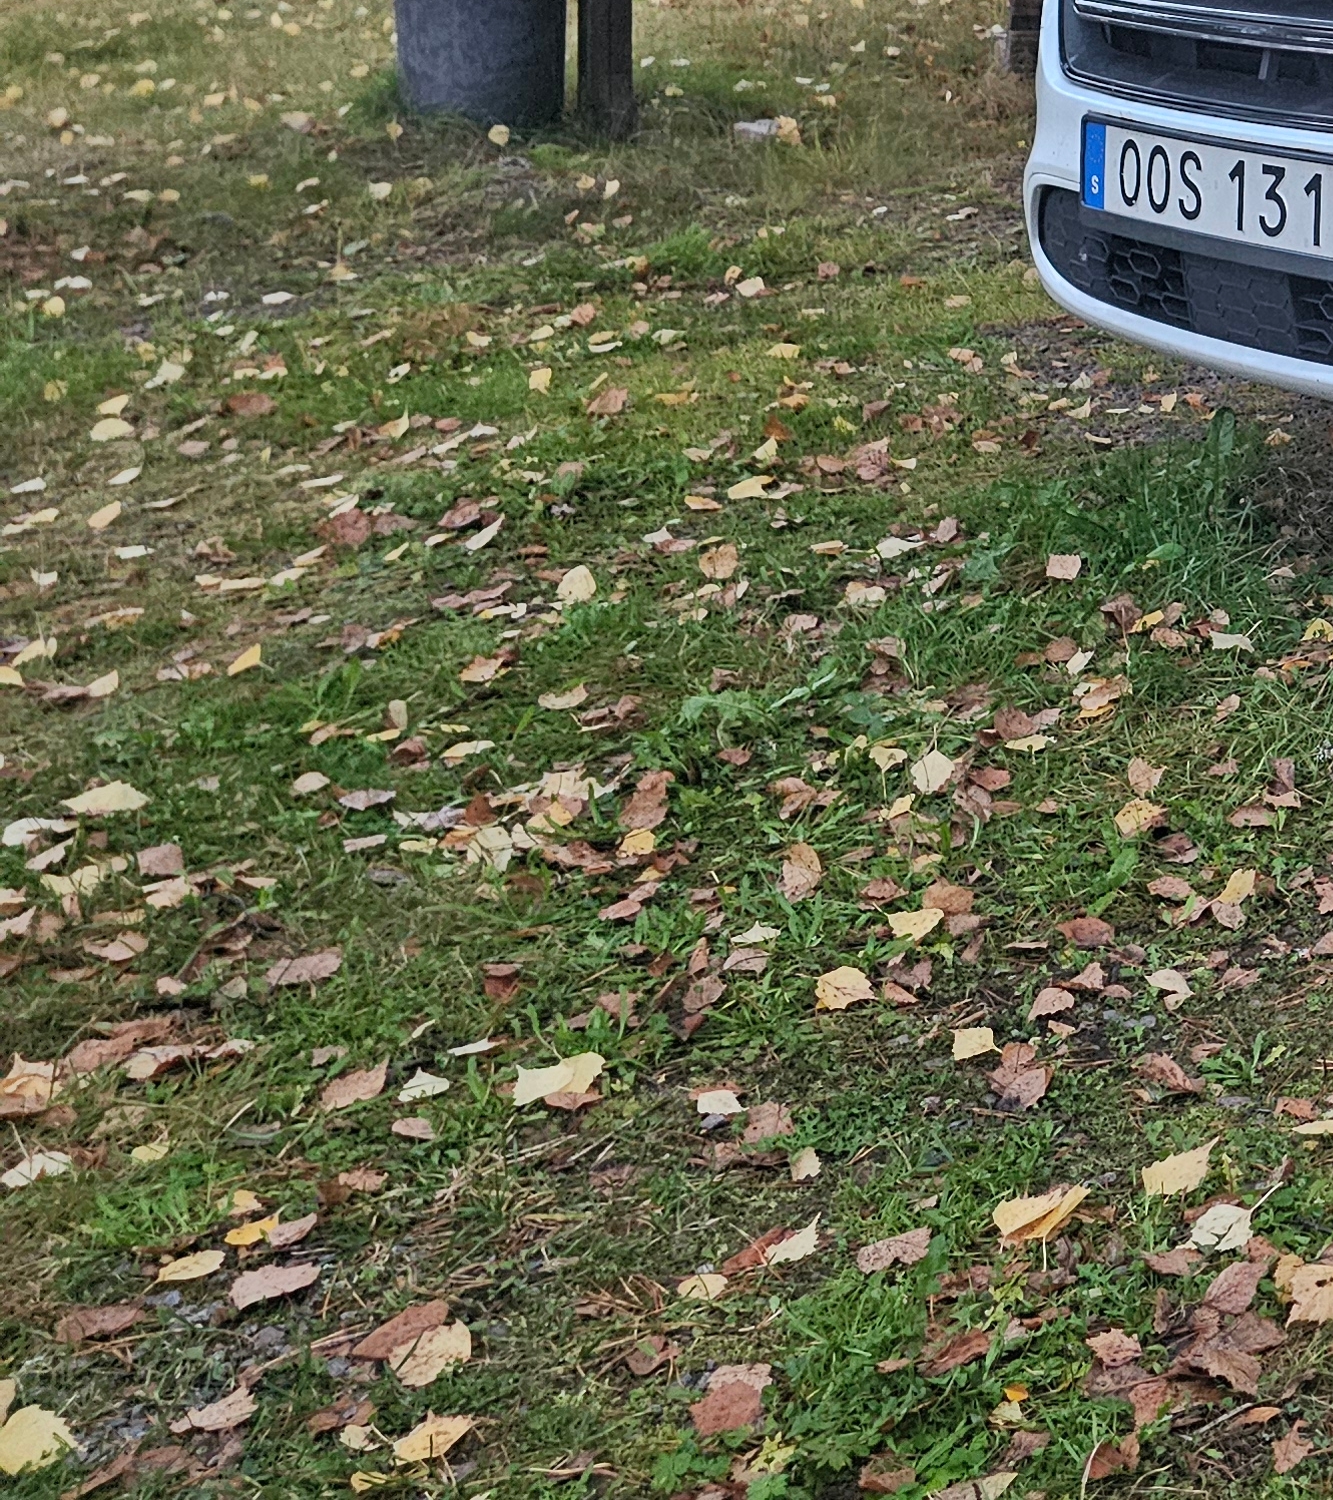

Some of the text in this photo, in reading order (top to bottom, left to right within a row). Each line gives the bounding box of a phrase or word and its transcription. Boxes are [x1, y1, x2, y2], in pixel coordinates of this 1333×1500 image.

[1091, 174, 1100, 195] S
[1119, 138, 1322, 247] OOS 131
